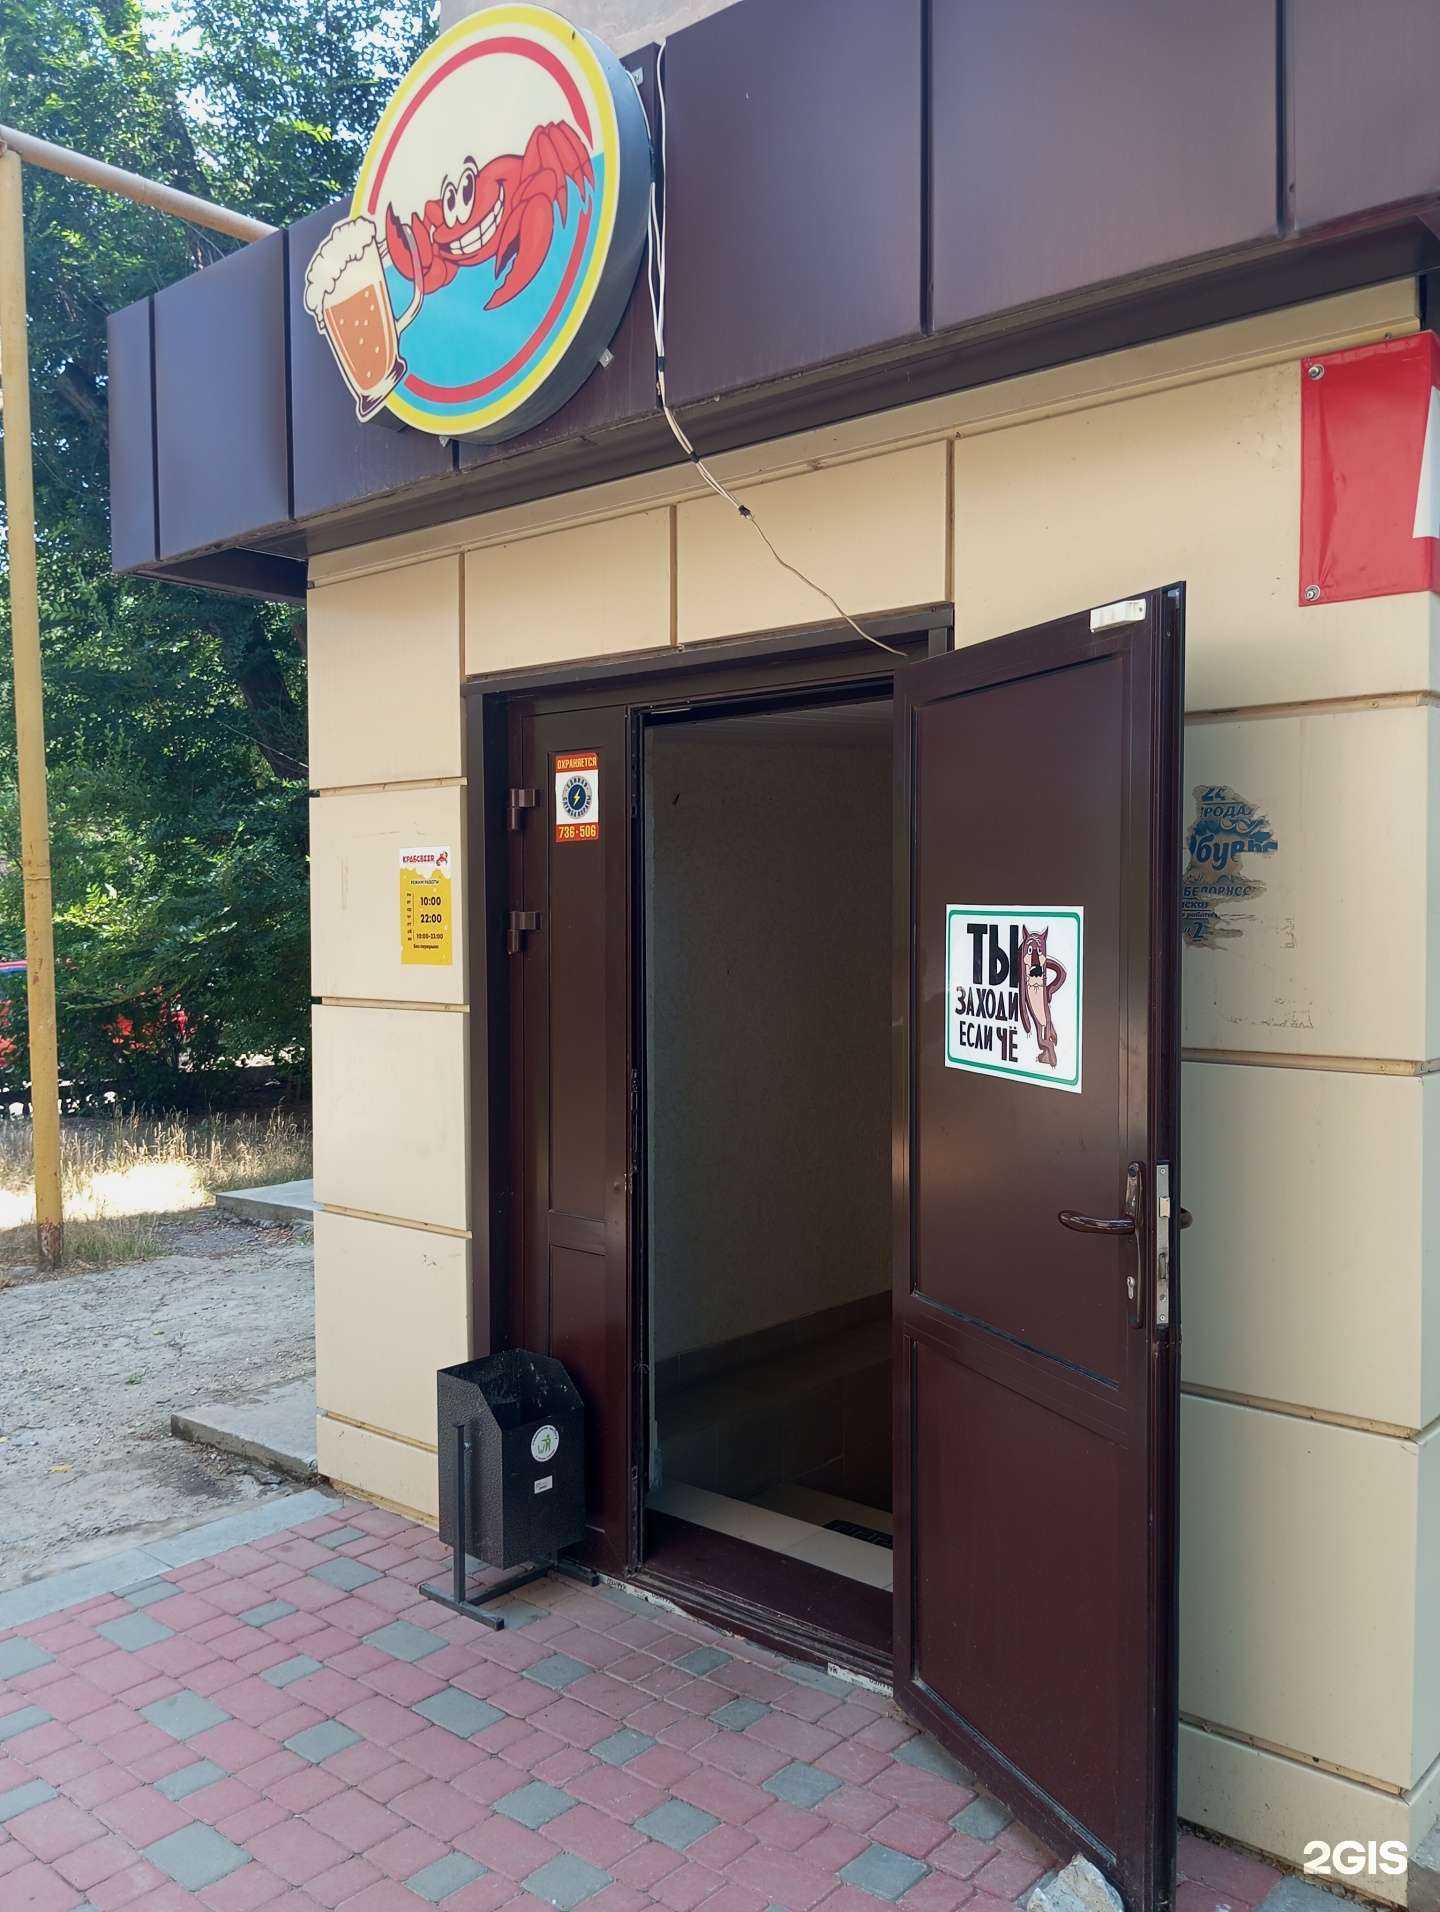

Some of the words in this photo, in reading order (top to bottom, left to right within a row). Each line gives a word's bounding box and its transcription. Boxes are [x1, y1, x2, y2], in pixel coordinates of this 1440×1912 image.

[557, 757, 597, 770] ОХРАНЯЕТСЯ
[420, 896, 441, 906] 10:00
[420, 914, 442, 923] 22:00
[967, 923, 1020, 989] ТЫ
[955, 986, 1019, 1022] ЗАХОДИ
[959, 1020, 993, 1052] ЕСЛИ
[995, 1026, 1019, 1063] ЧЁ
